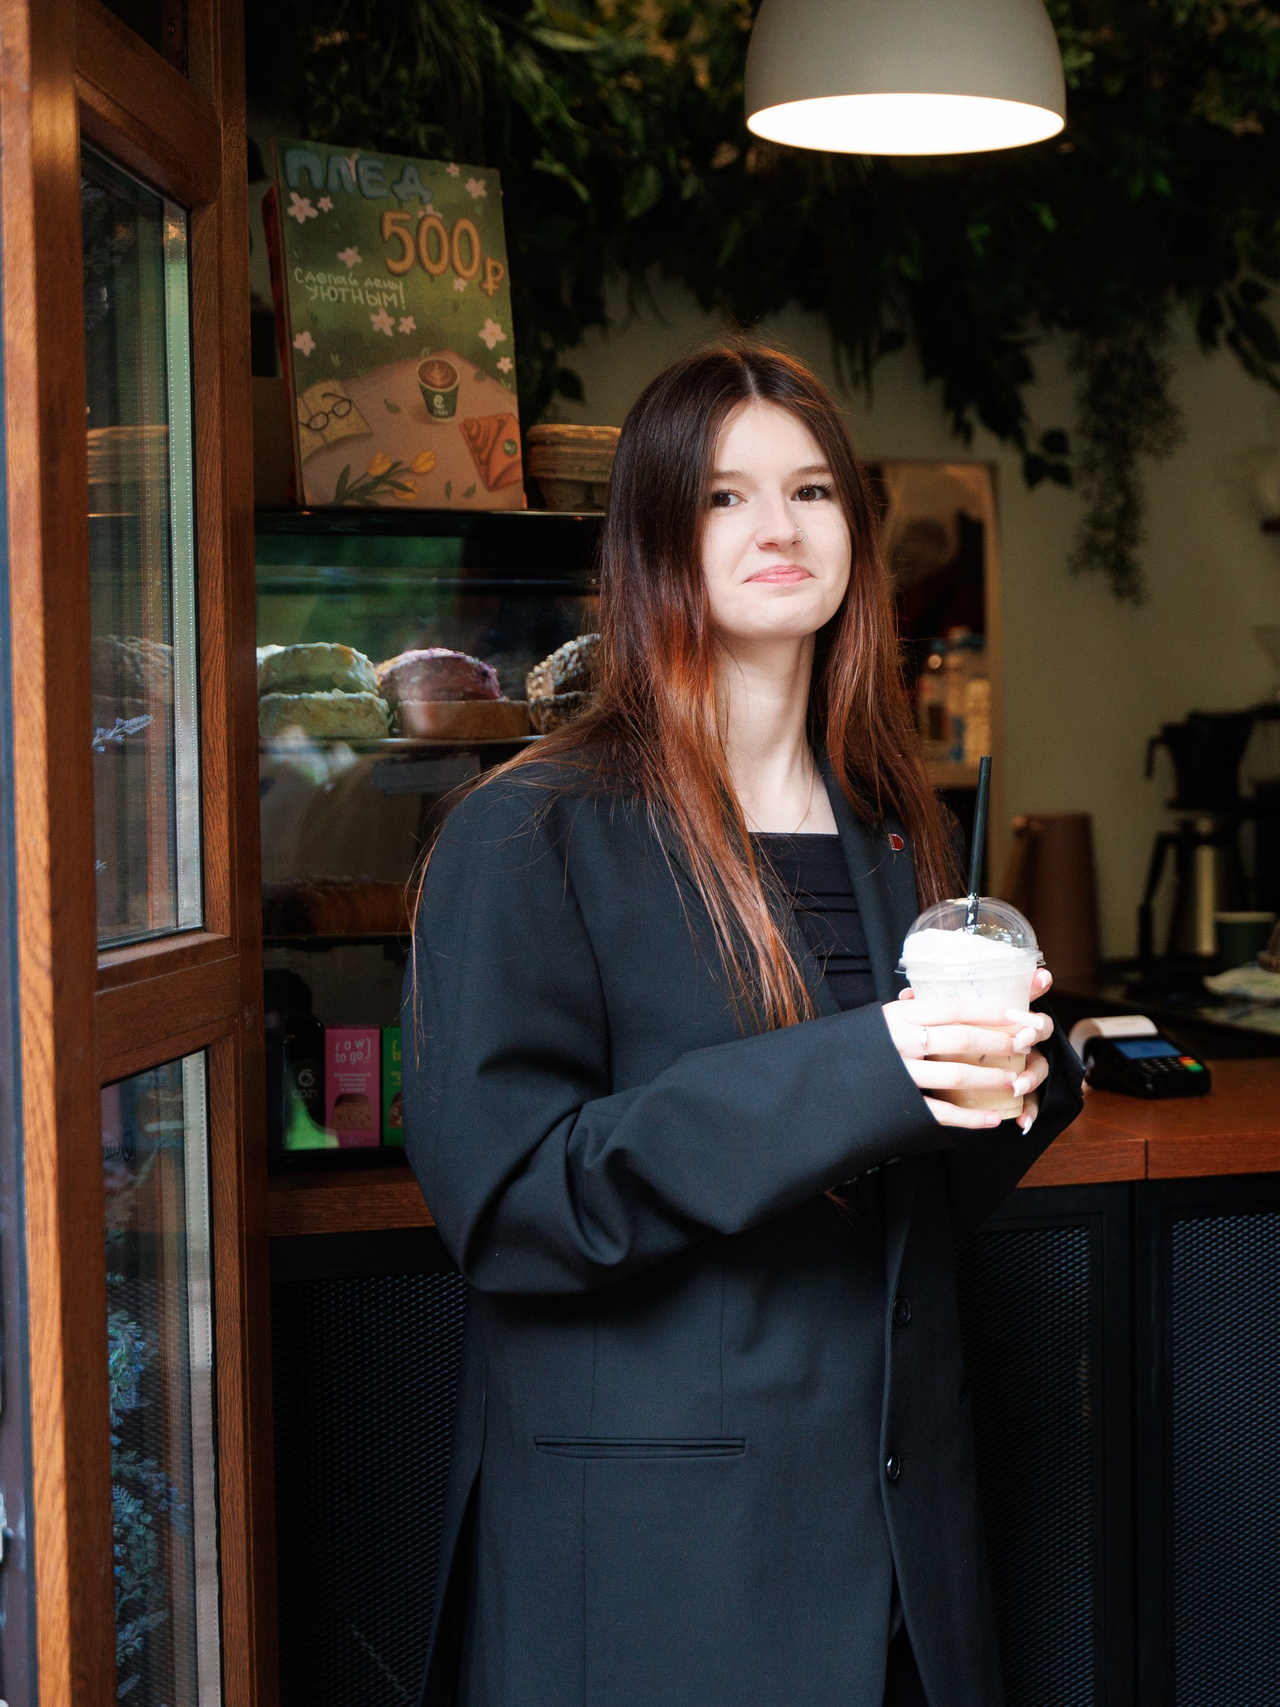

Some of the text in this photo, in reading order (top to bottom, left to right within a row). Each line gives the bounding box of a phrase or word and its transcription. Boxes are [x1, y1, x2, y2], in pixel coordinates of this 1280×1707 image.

[284, 150, 435, 205] ПЛЕД
[364, 277, 399, 290] день
[304, 280, 407, 310] УЮТНЫМ!
[335, 1051, 363, 1065] to go
